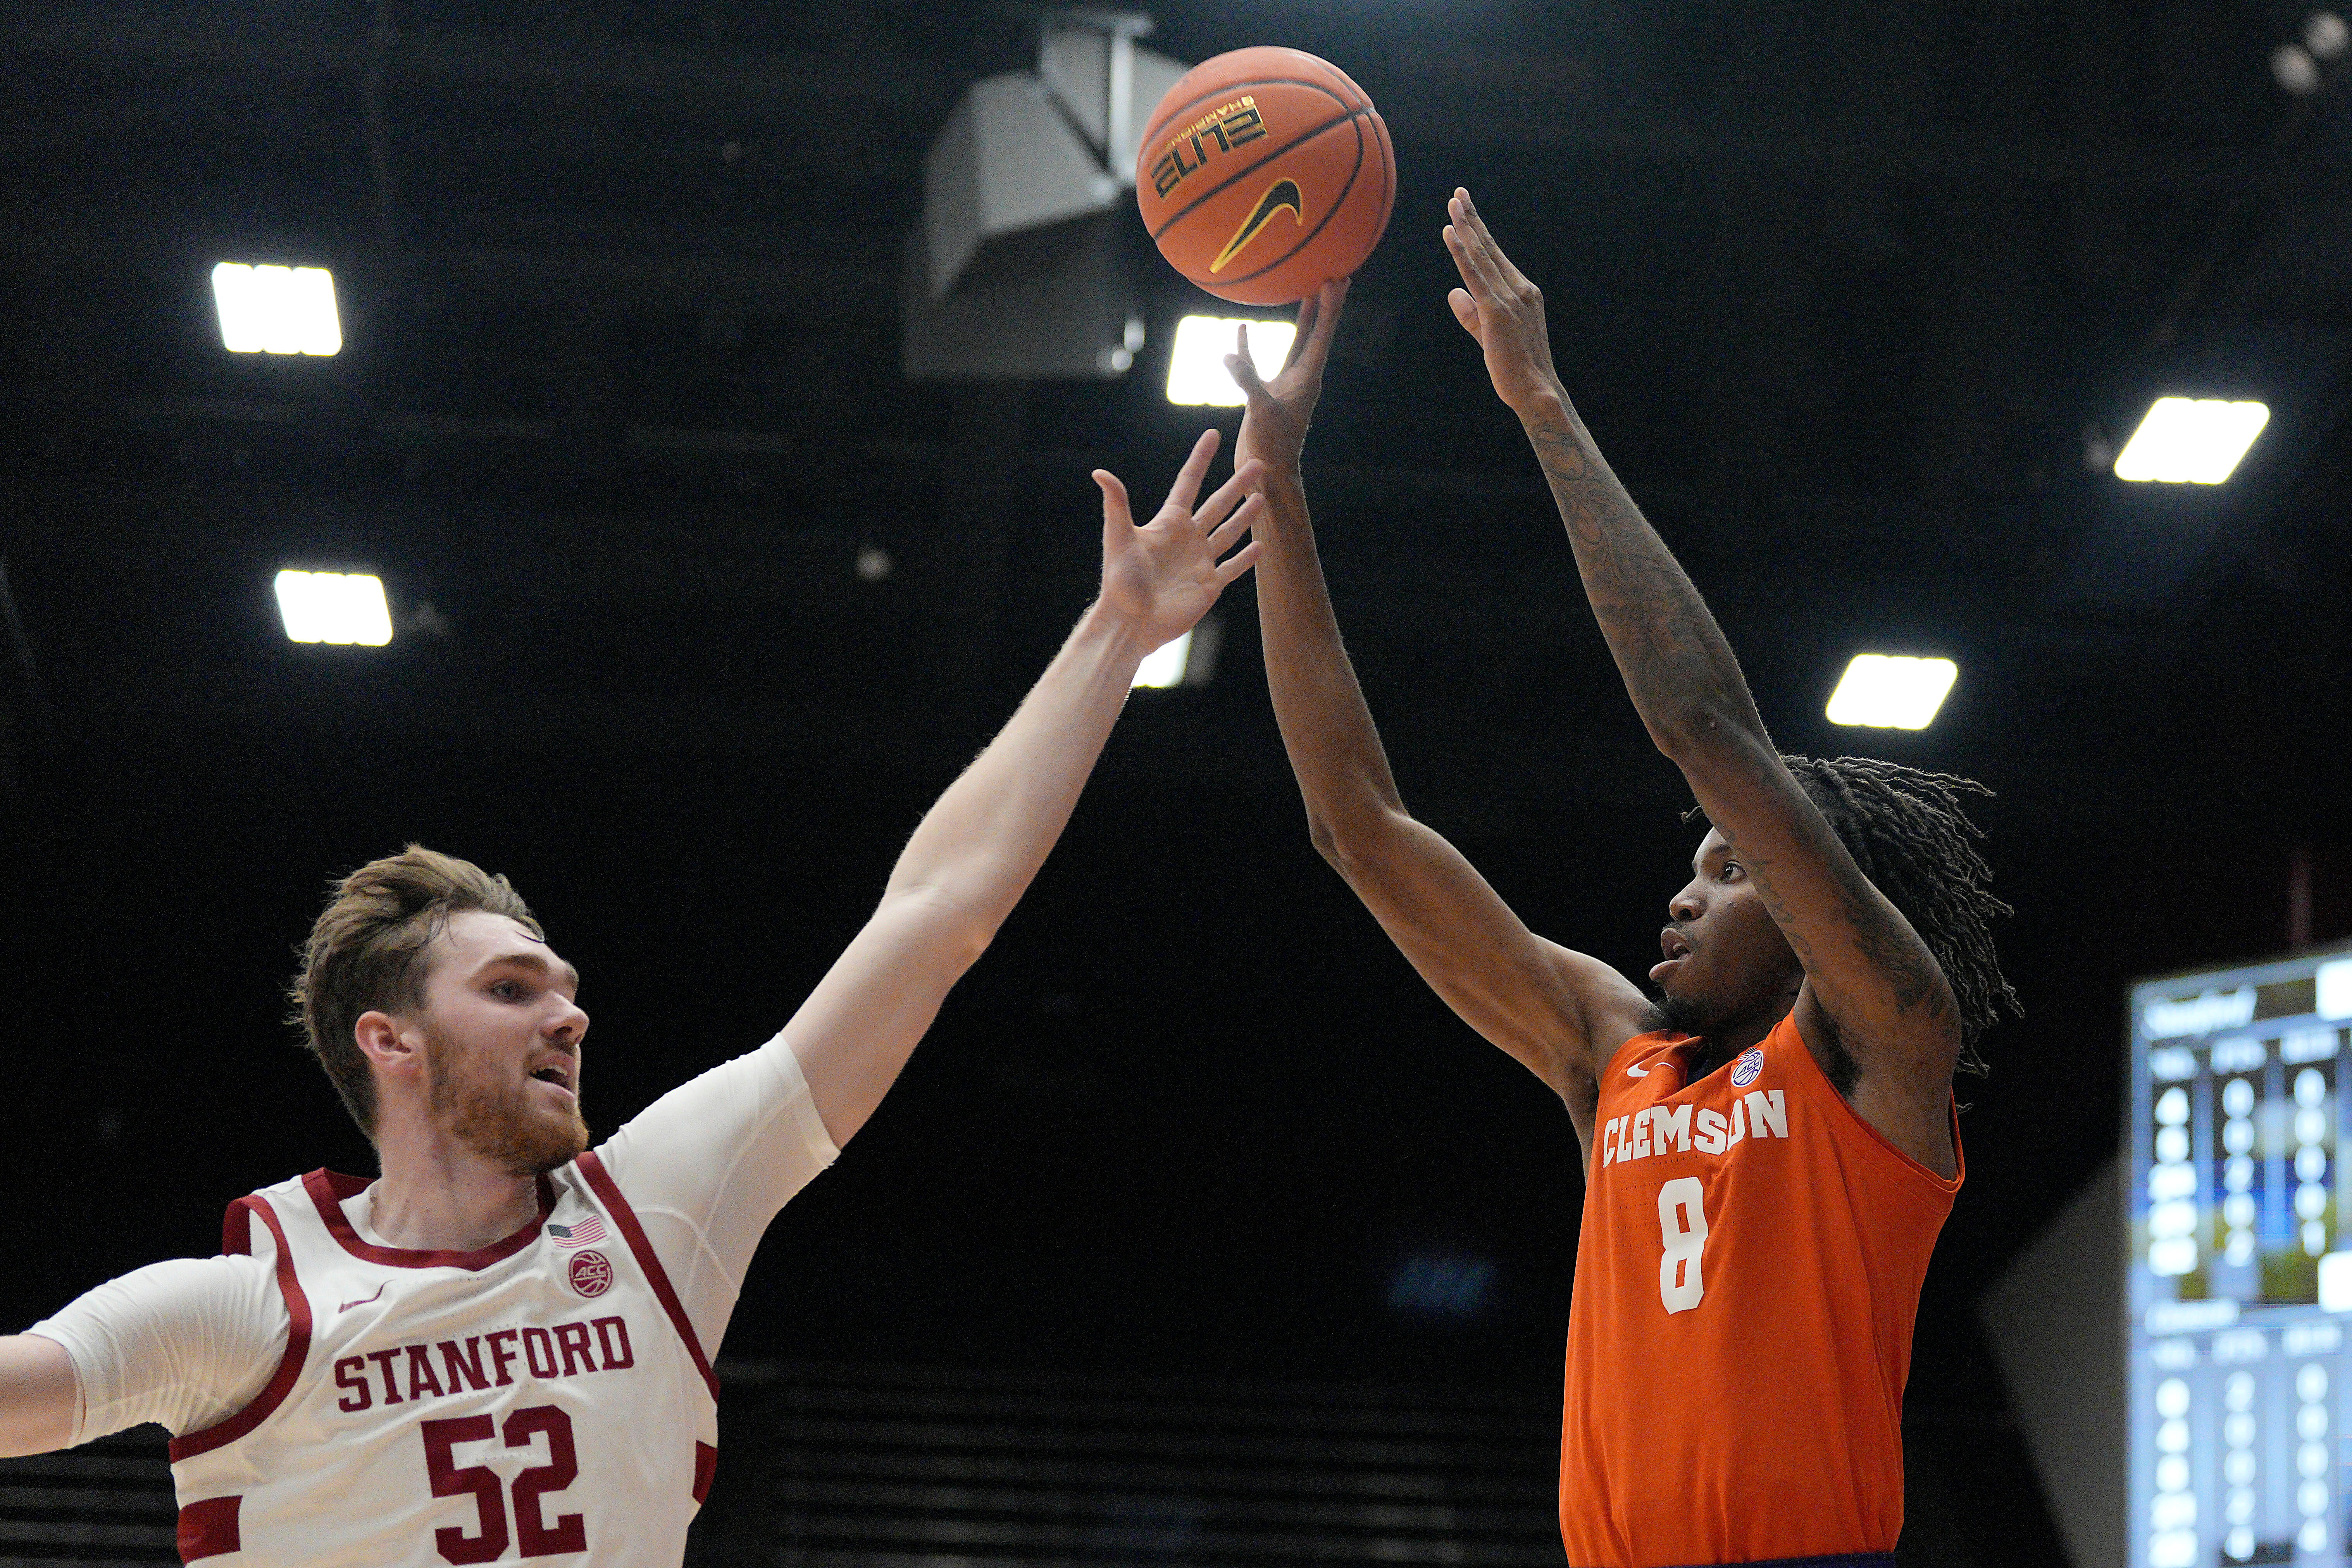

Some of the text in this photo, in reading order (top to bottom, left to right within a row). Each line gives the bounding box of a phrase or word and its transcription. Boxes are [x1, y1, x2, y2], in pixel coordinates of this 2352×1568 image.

[1152, 104, 1266, 199] ELITE
[1736, 1056, 1760, 1077] ACC
[1603, 1089, 1789, 1168] CLEMSON
[575, 1264, 608, 1279] ACC
[1658, 1177, 1709, 1315] 8
[334, 1316, 635, 1413] STANFORD
[420, 1404, 588, 1566] 52
